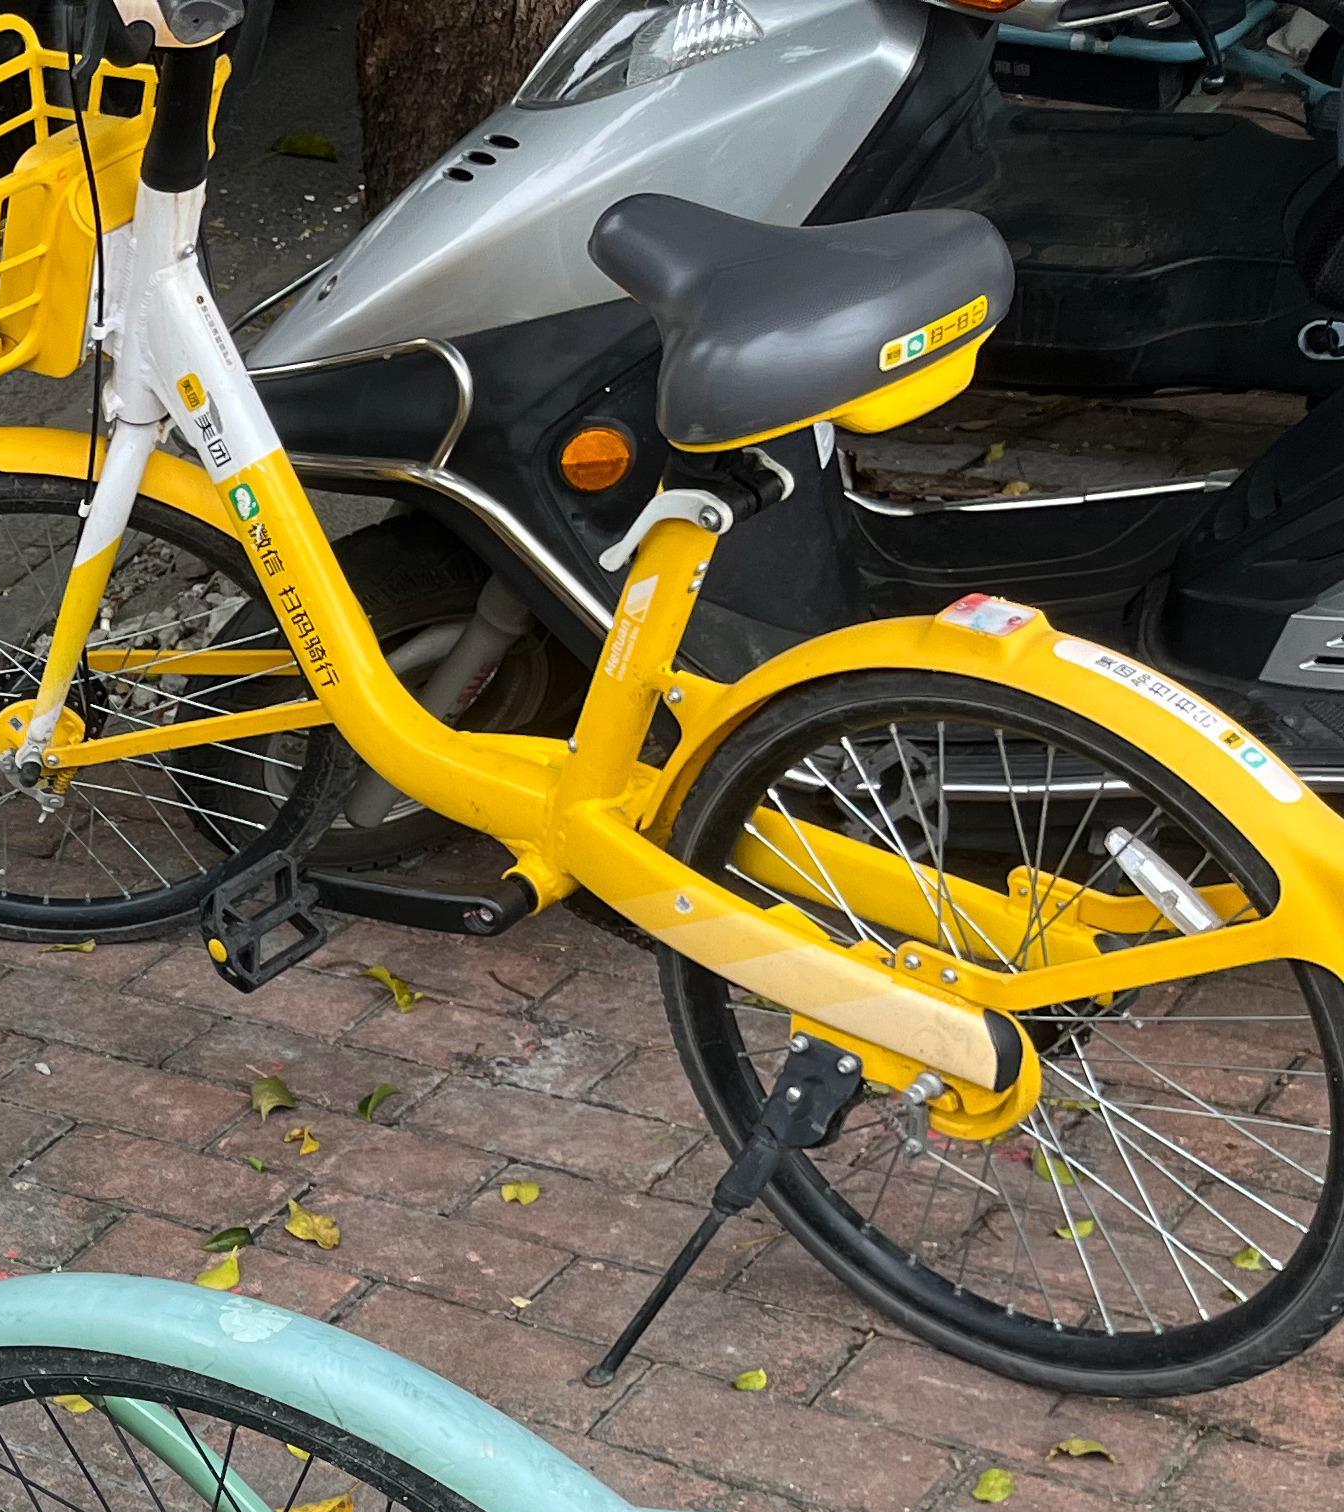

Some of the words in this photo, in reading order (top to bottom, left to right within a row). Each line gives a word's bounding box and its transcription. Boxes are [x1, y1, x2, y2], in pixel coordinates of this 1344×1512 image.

[194, 412, 232, 468] 美团
[248, 523, 285, 577] 微信
[277, 585, 340, 687] 扫码骑行
